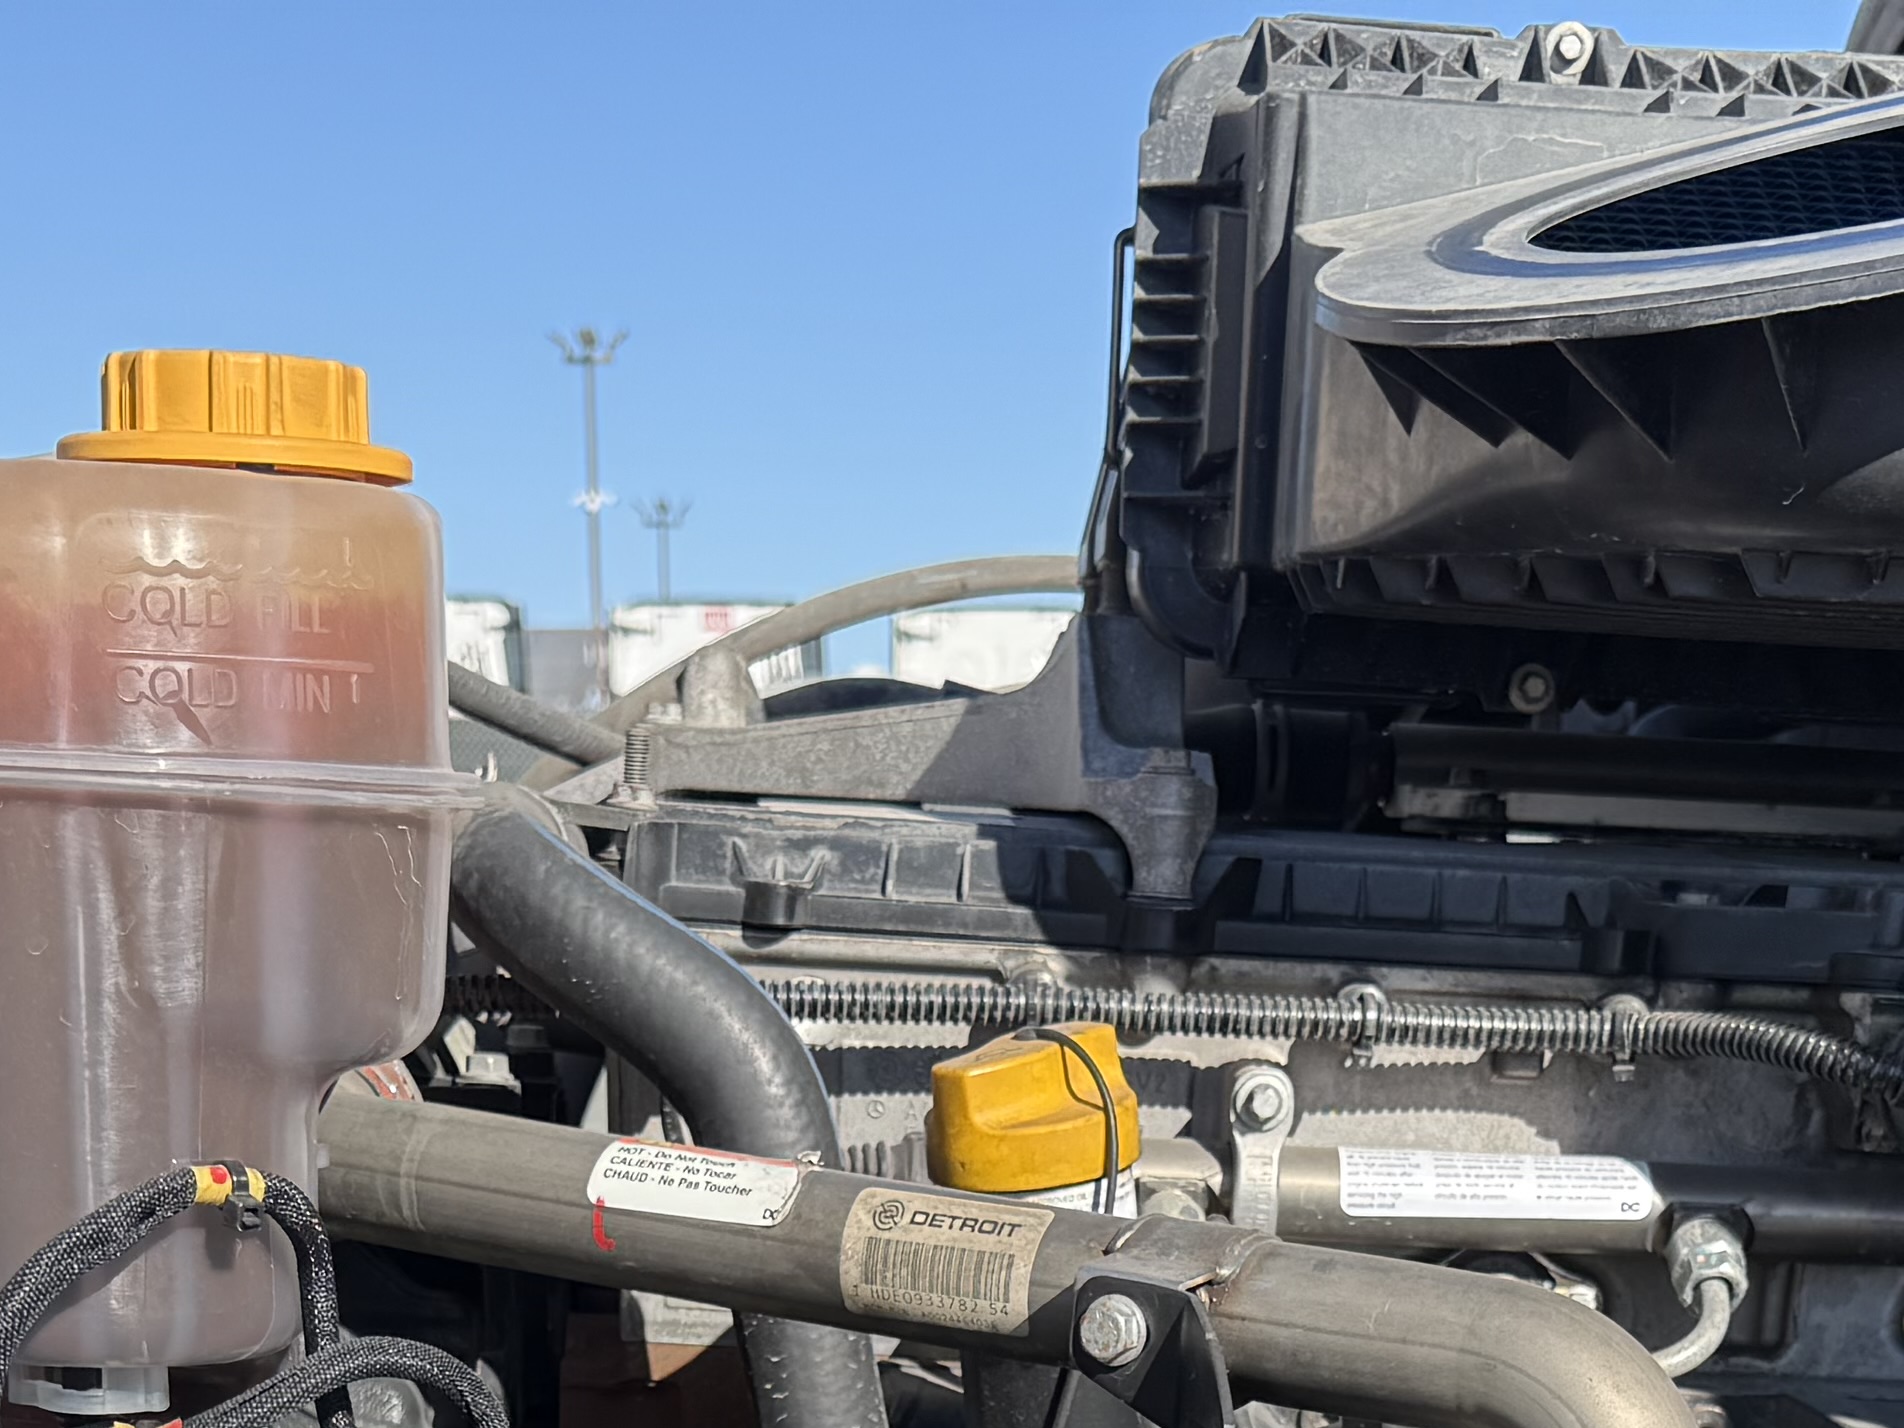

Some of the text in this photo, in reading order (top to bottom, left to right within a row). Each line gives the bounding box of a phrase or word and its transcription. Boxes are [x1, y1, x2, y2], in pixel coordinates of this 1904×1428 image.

[101, 583, 332, 635] COLD FILL
[114, 665, 238, 710] COLD
[609, 1155, 738, 1181] CALIENTE No Tocar
[654, 1151, 672, 1160] Do
[603, 1167, 649, 1184] CHAUD
[703, 1181, 754, 1197] Toucher
[909, 1210, 1023, 1237] DETROIT
